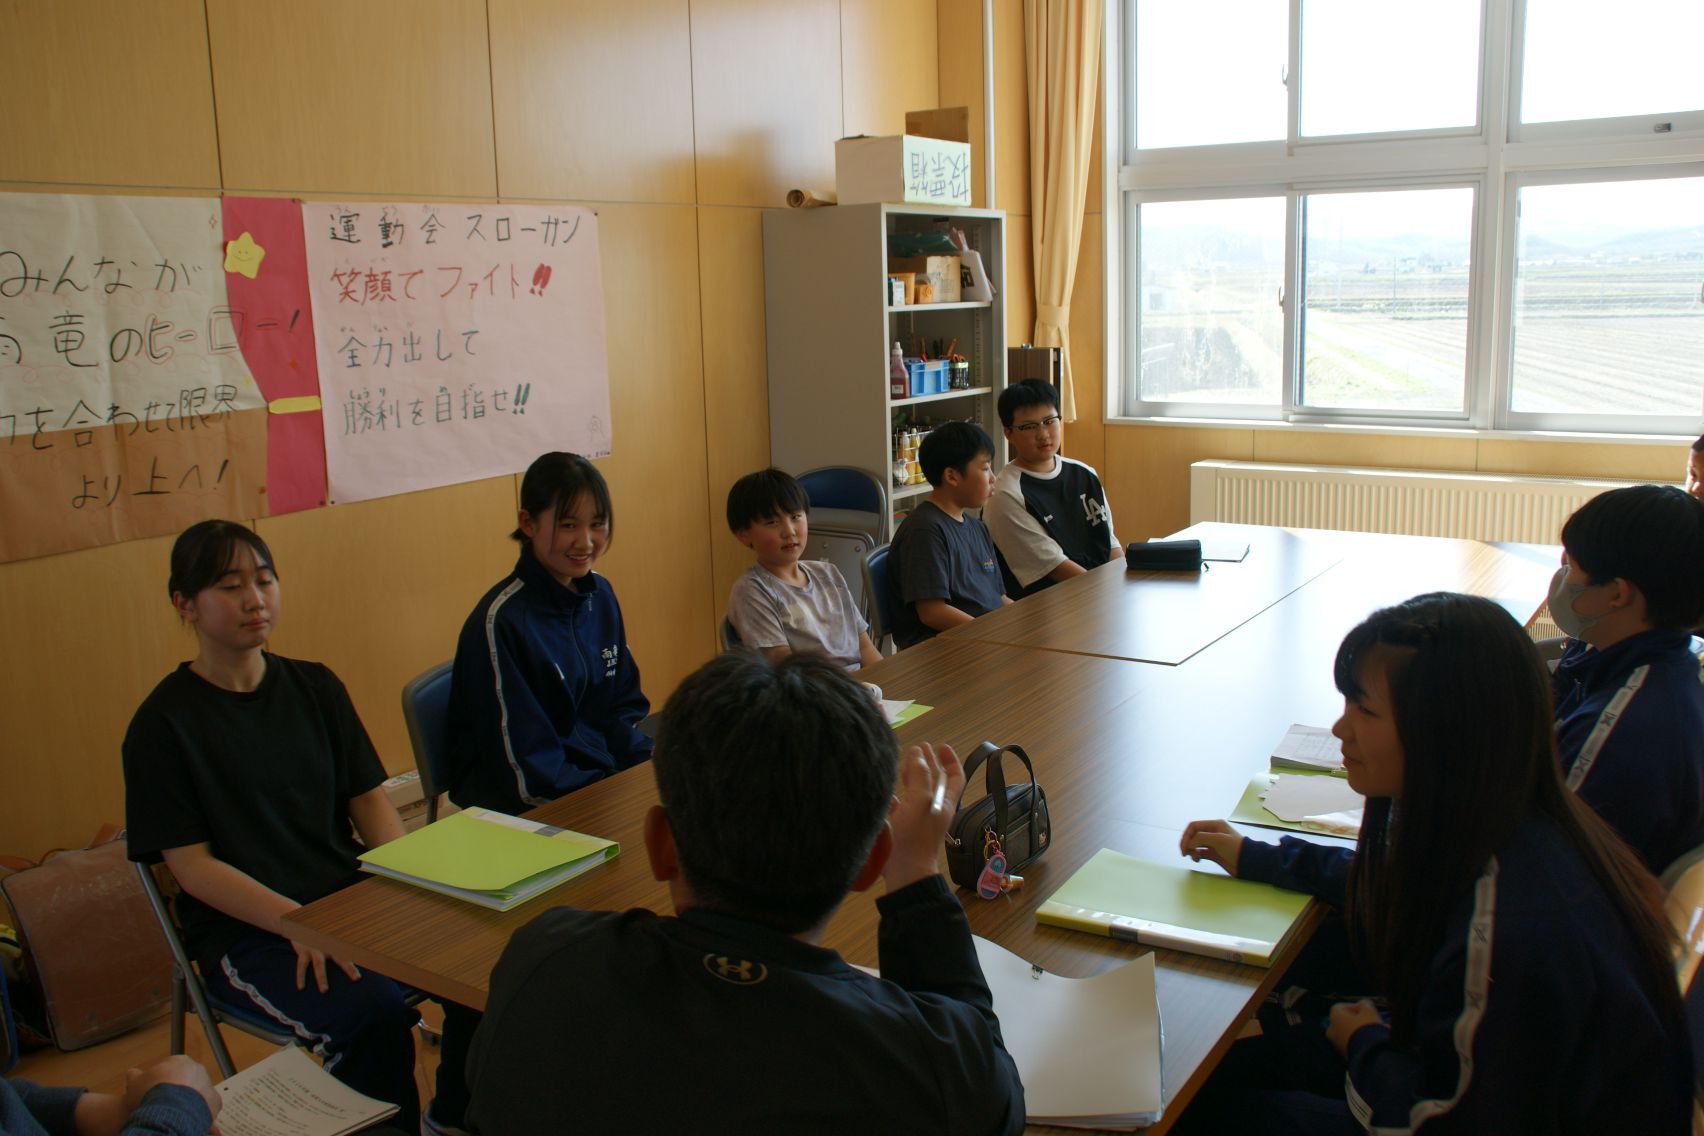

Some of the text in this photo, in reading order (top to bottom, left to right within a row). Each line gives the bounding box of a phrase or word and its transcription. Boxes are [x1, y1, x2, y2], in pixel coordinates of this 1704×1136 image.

[0, 250, 203, 298] みんなが
[337, 329, 480, 368] 全力出して
[72, 456, 230, 509] より上へ!
[1080, 493, 1108, 527] LA
